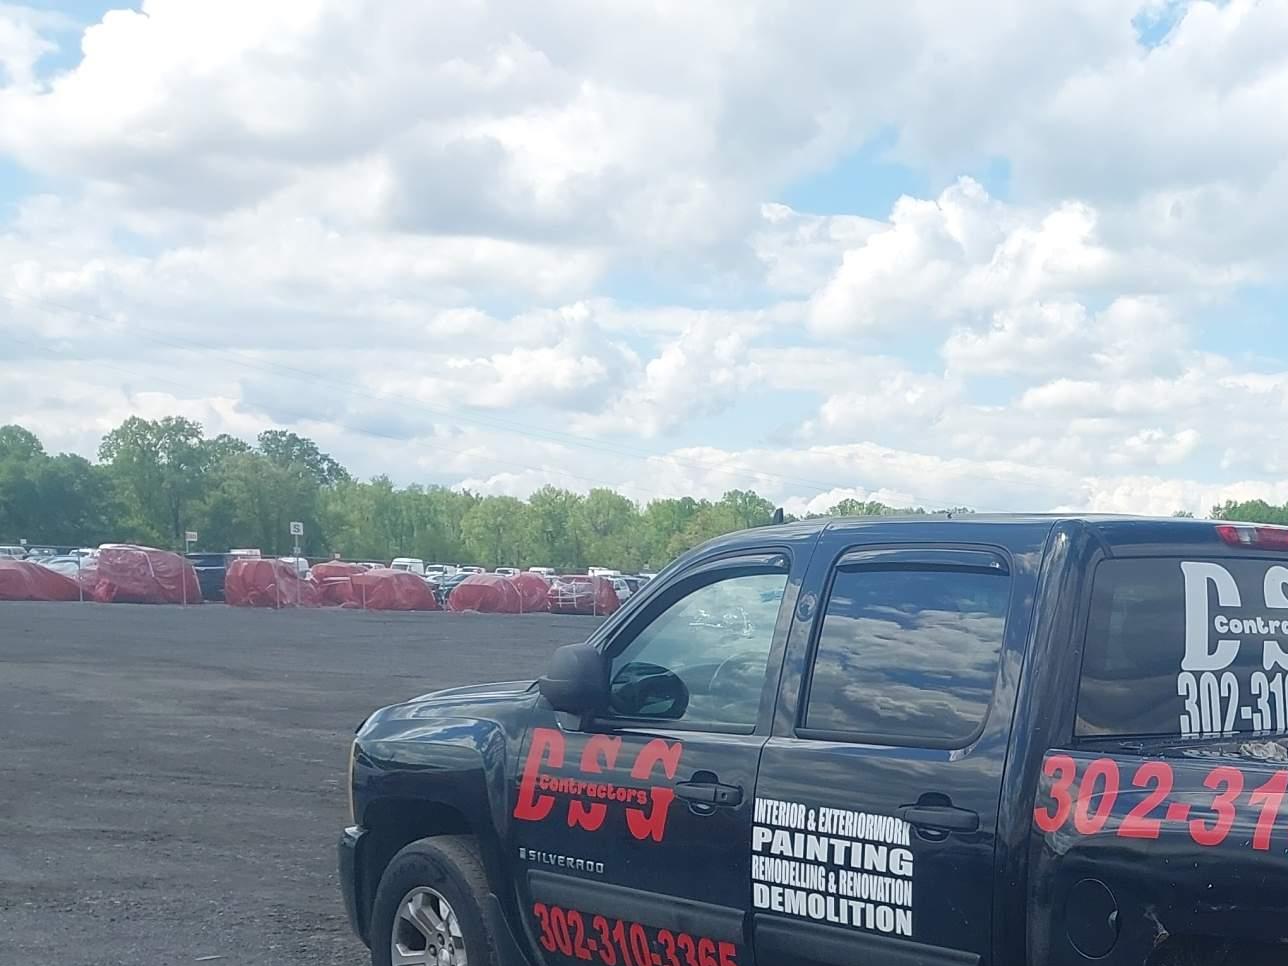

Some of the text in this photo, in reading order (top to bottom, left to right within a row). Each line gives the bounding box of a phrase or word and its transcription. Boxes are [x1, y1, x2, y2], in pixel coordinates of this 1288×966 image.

[540, 774, 648, 804] Contractors
[754, 798, 911, 846] INTERIOR & EXTERIORWORK
[529, 850, 604, 873] SILVERADO
[752, 826, 914, 876] PAINTING
[752, 855, 913, 907] REMODELLING & RENOVATION
[753, 883, 913, 936] DEMOLITION
